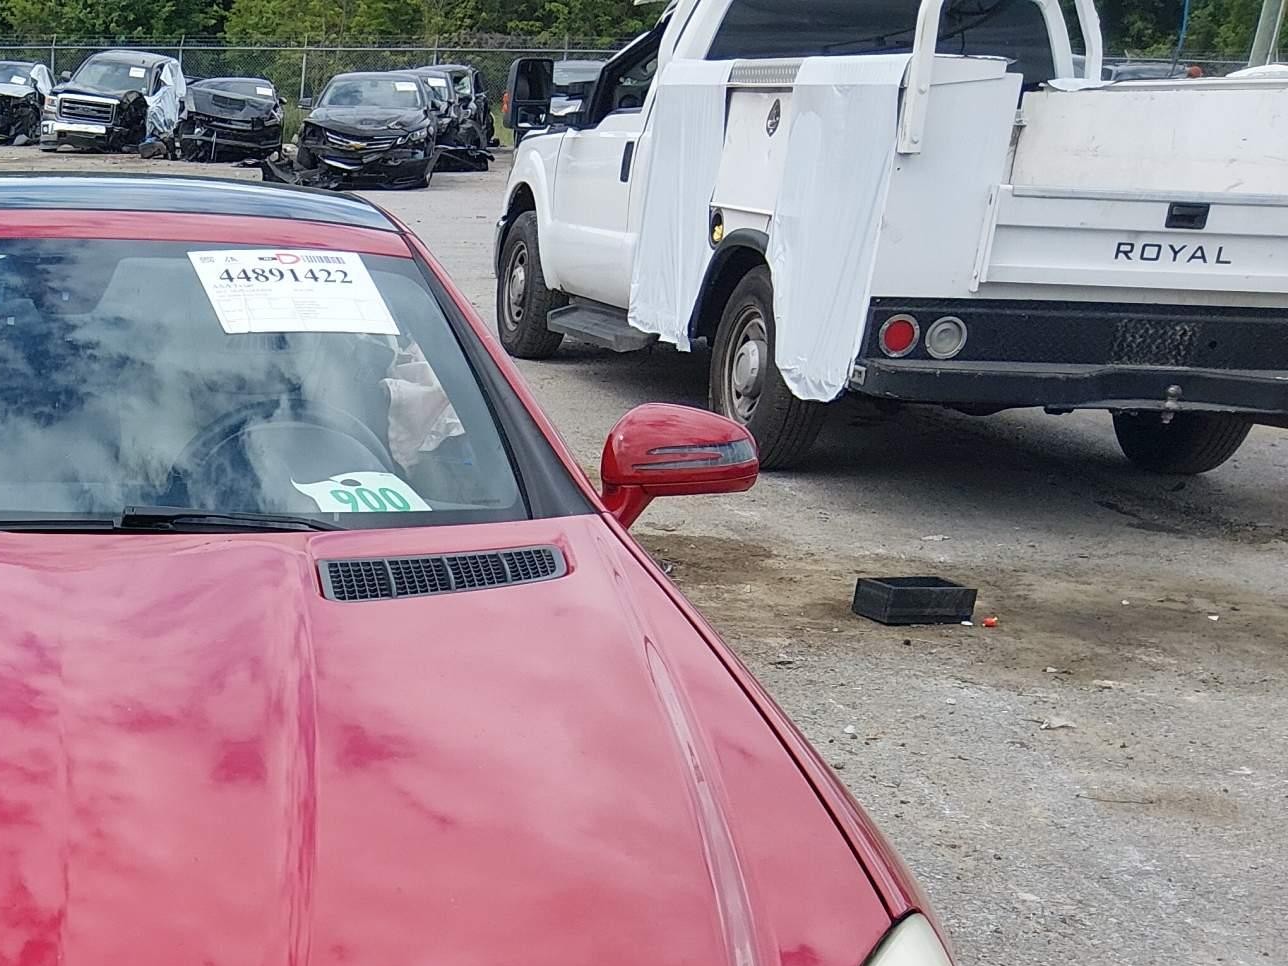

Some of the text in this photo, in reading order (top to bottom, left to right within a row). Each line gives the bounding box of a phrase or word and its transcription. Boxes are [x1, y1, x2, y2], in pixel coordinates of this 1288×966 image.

[1114, 242, 1232, 265] ROYAL
[219, 267, 353, 285] 44891422
[330, 488, 411, 512] 900
